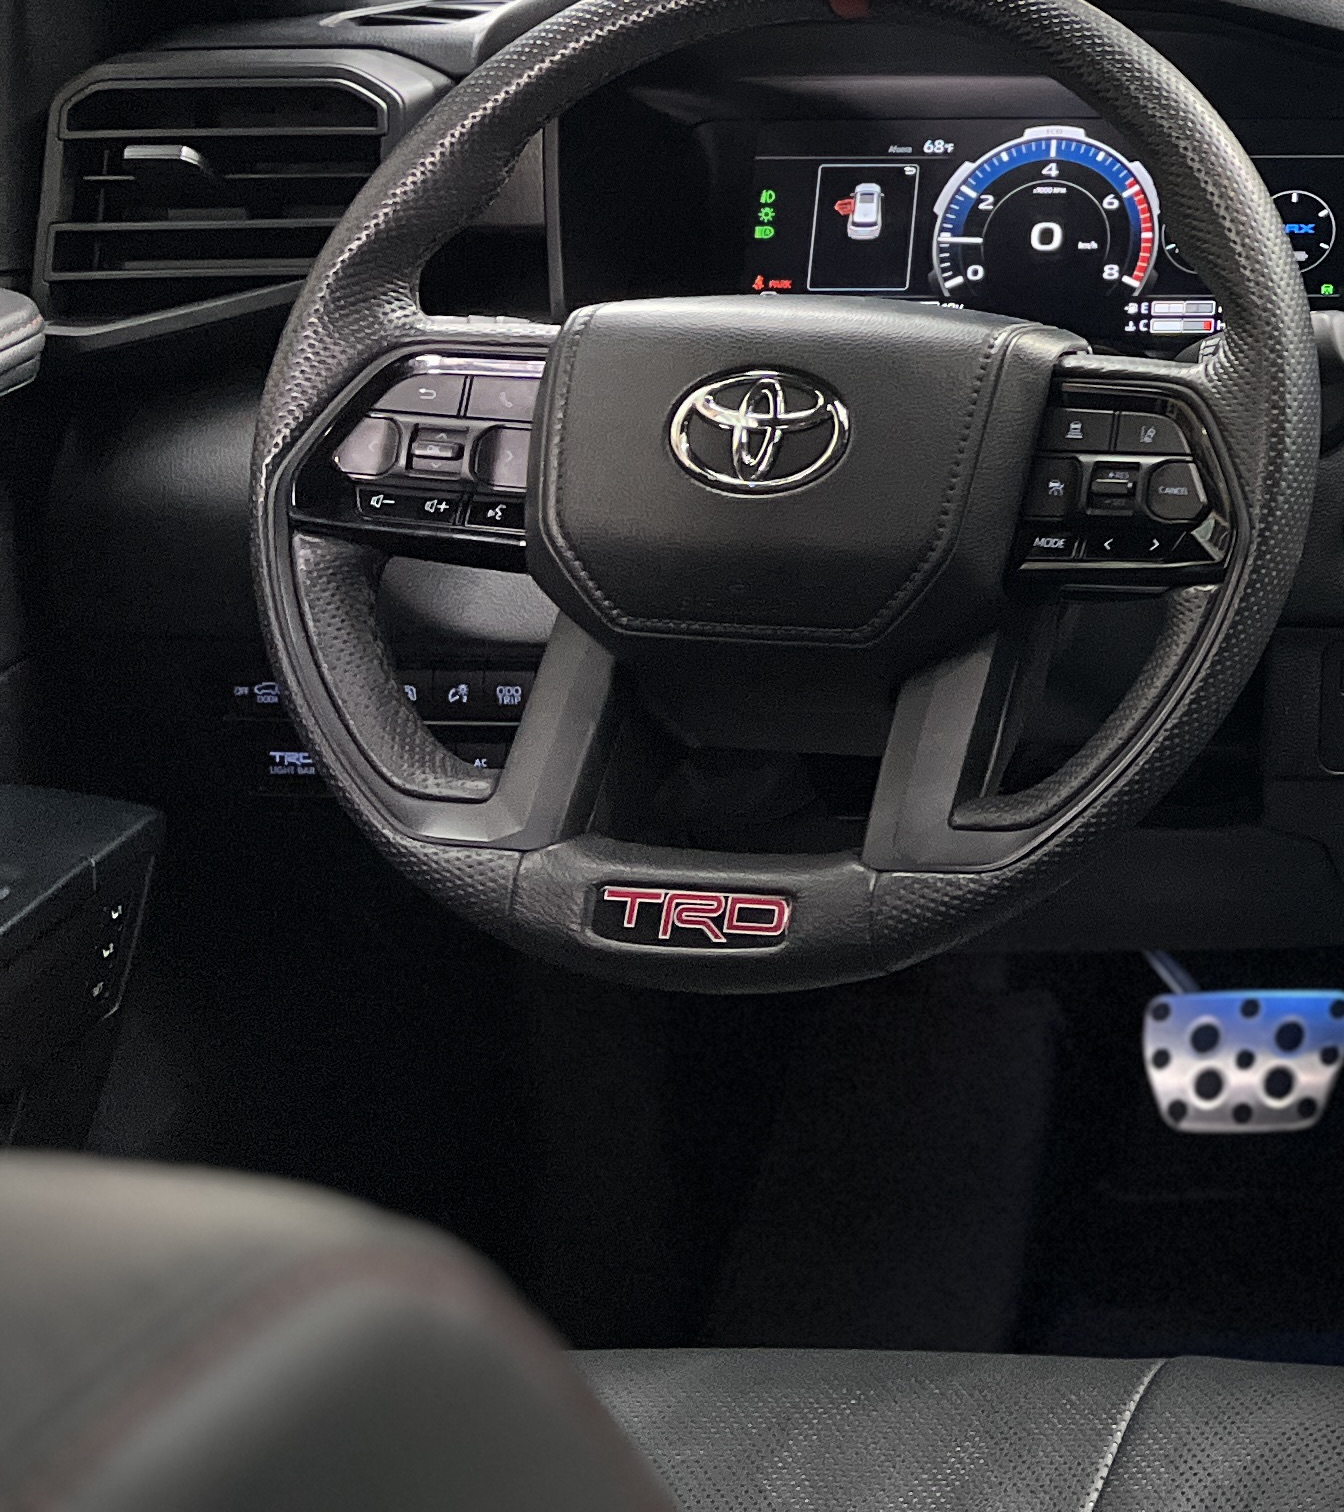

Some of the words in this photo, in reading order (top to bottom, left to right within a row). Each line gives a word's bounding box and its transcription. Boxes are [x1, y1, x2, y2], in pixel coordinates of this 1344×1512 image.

[1042, 163, 1059, 177] 4
[978, 194, 994, 210] 2
[1102, 194, 1119, 209] 6
[1031, 222, 1062, 251] 0
[966, 265, 984, 280] 0
[1103, 264, 1122, 282] 8
[1141, 302, 1149, 314] E
[1139, 320, 1149, 333] C
[1159, 486, 1188, 495] CANCEL
[1033, 538, 1066, 548] MODE
[496, 686, 522, 695] ODO
[498, 695, 522, 705] TRIP
[603, 886, 790, 942] TRD
